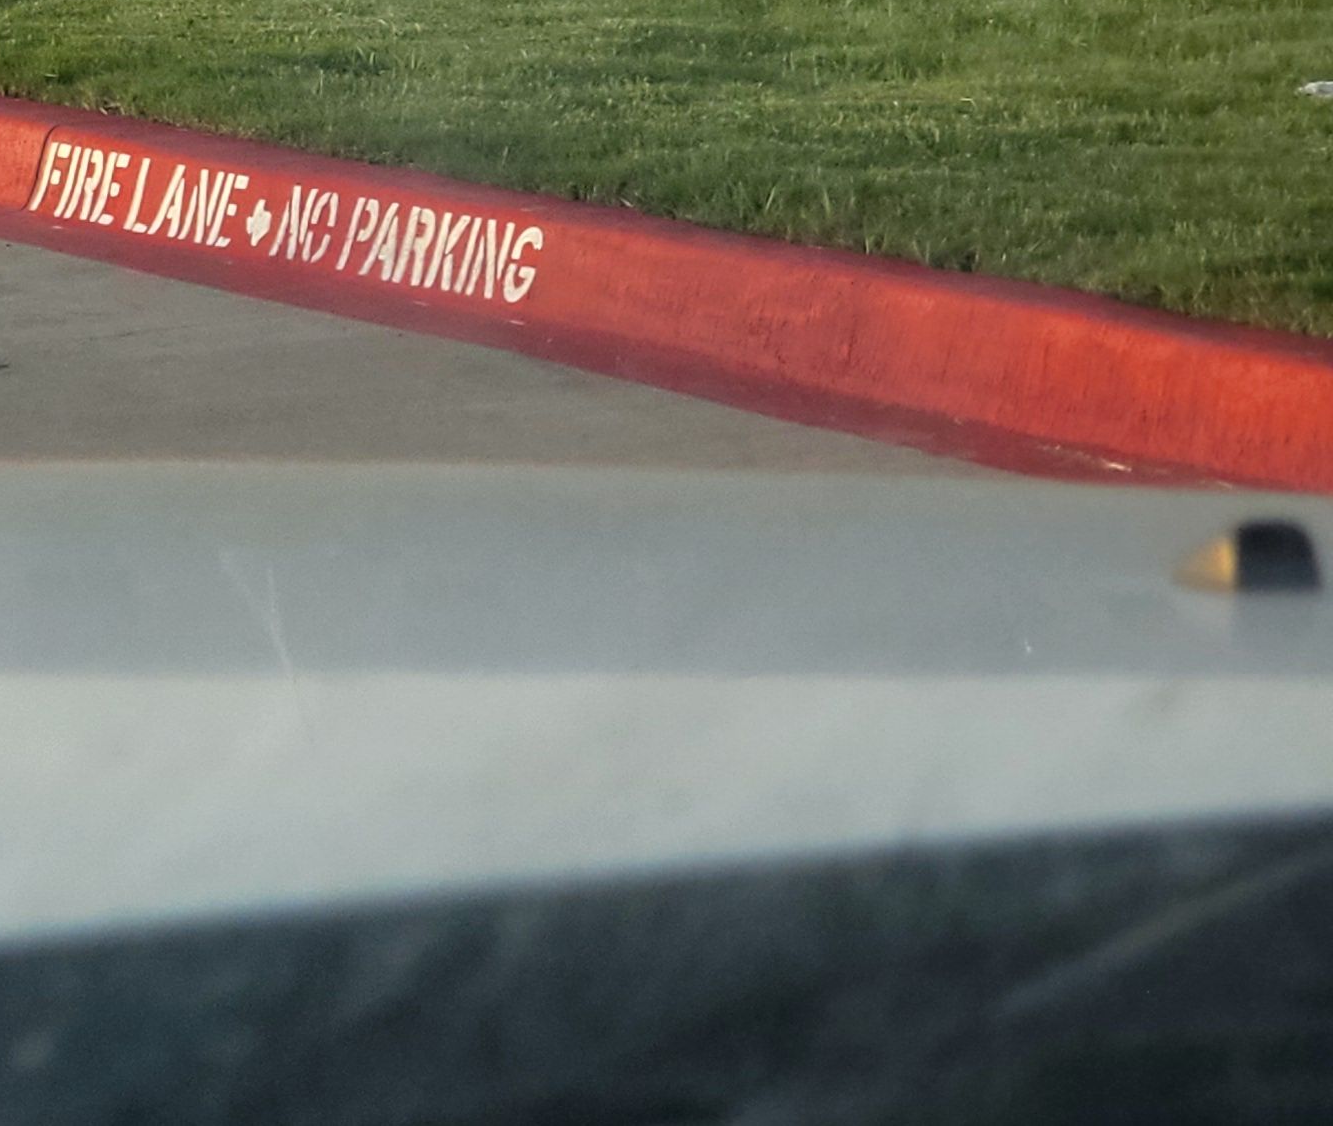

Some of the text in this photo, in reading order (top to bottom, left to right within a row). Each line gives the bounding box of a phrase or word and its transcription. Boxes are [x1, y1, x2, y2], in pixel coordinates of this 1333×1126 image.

[29, 142, 544, 303] FIRE LANE NO PARKING
